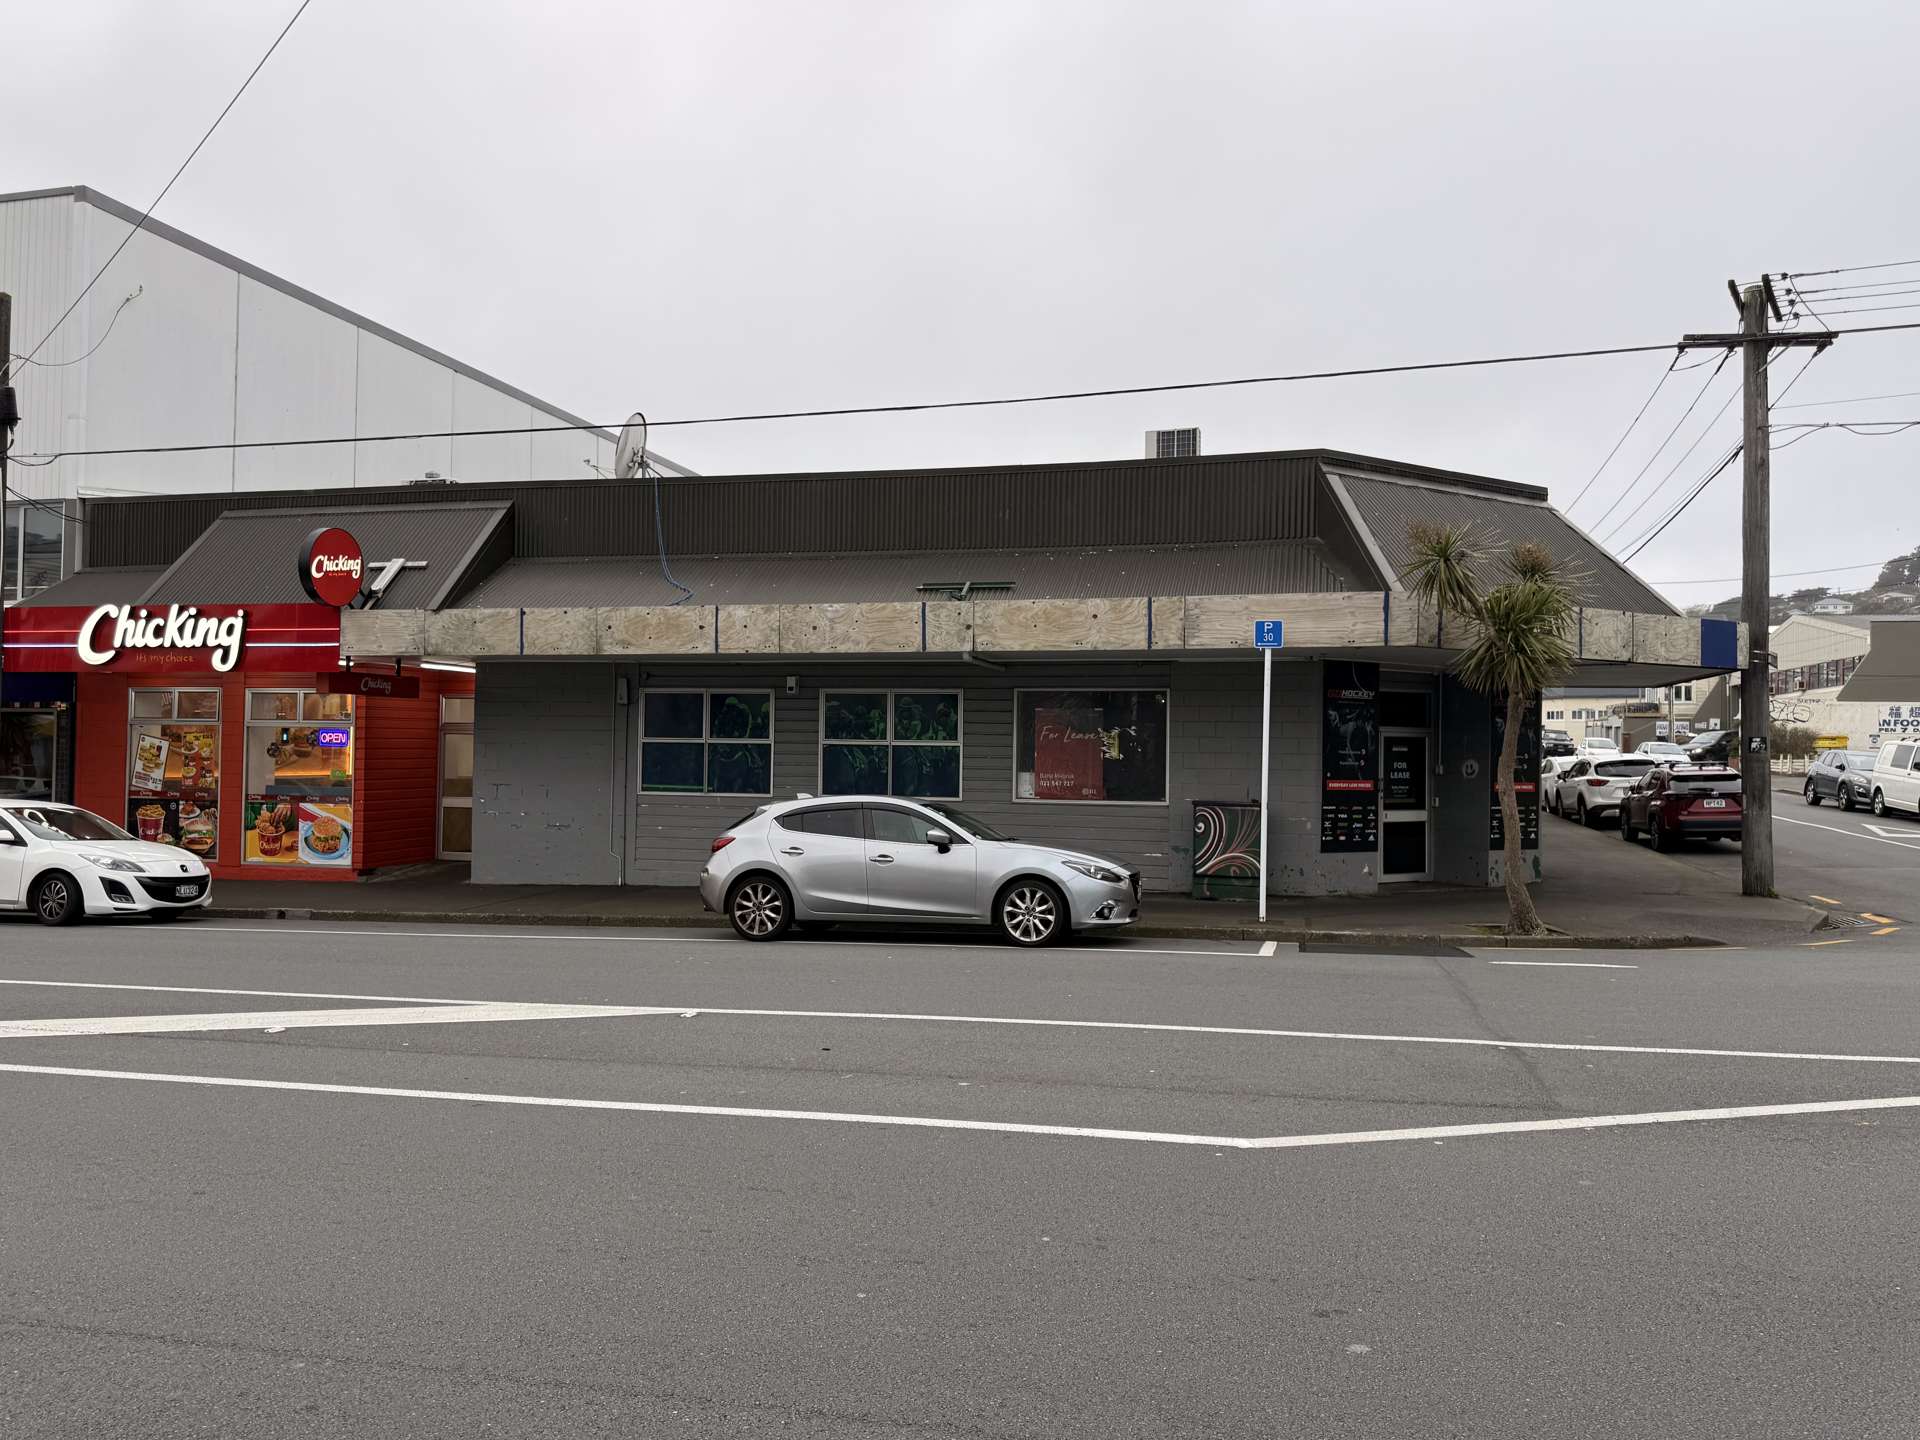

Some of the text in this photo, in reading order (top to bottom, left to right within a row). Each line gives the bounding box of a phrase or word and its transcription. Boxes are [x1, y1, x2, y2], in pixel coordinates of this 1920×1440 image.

[310, 554, 362, 579] Chicking
[1264, 622, 1273, 633] P
[77, 603, 244, 673] Chicking
[1263, 633, 1274, 642] 30
[360, 677, 392, 695] Chicking
[321, 733, 346, 743] OPEN
[1040, 725, 1059, 741] For
[1393, 761, 1407, 769] FOR
[1390, 771, 1410, 779] LEASE
